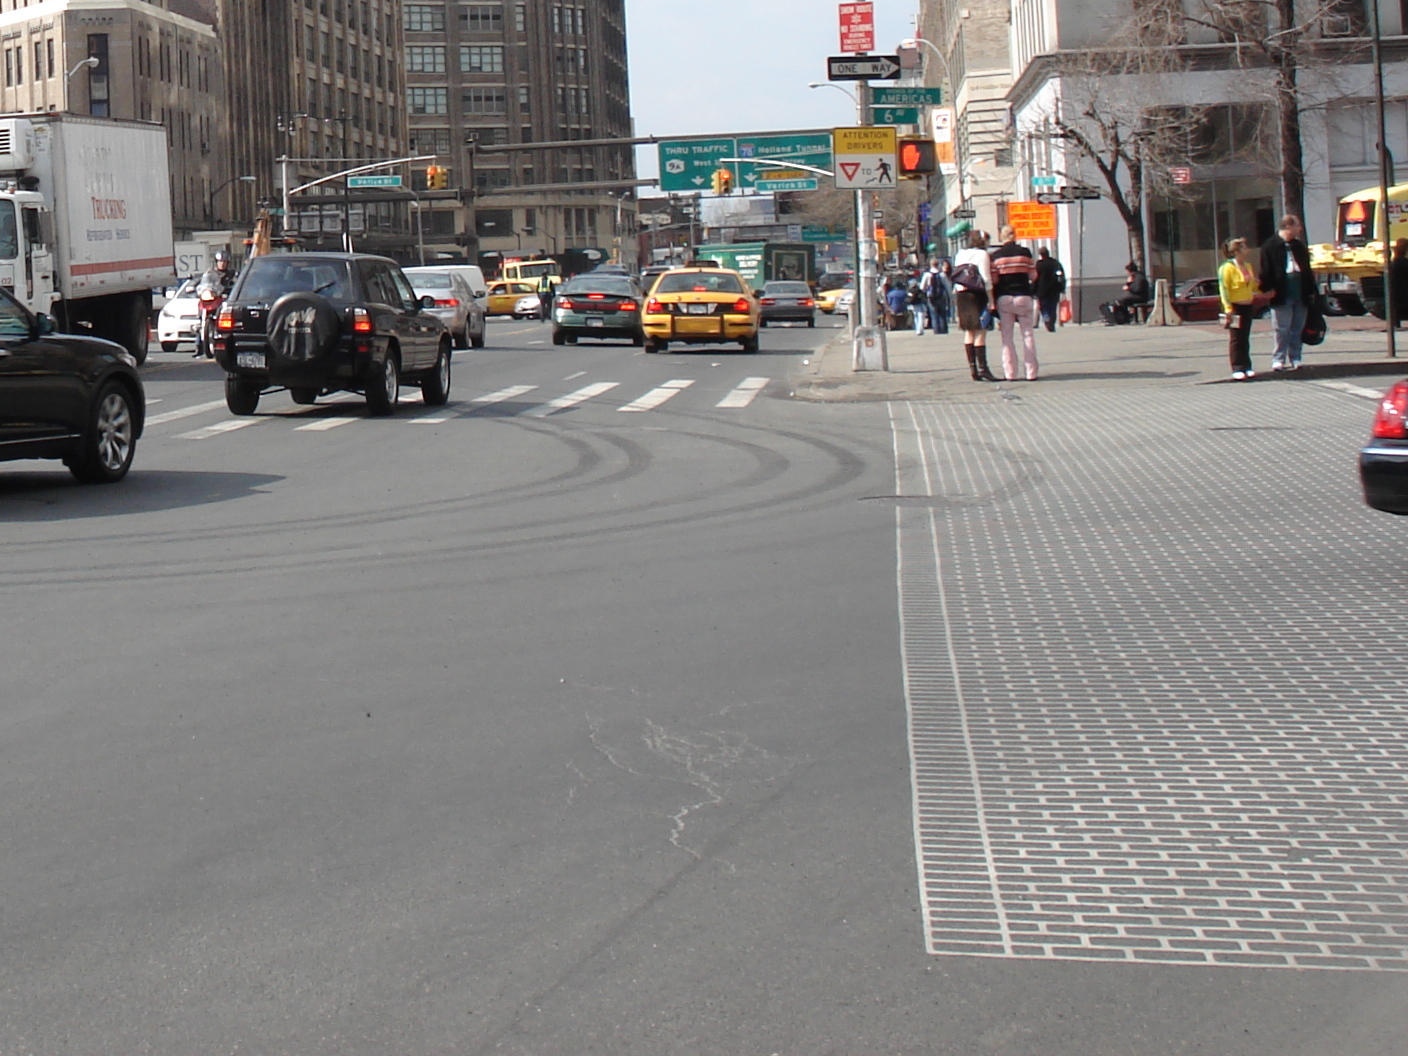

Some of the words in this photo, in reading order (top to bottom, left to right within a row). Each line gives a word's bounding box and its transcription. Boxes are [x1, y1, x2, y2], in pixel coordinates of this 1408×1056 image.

[837, 64, 858, 74] ONE
[872, 62, 892, 73] WAY
[880, 94, 933, 104] AMERICAS
[884, 109, 894, 123] 6
[843, 131, 888, 139] ATTENTION
[665, 146, 689, 155] THRU
[692, 144, 728, 154] TRAFFIC
[758, 146, 792, 154] Holland
[847, 142, 883, 150] DRIVERS
[861, 168, 872, 176] TO
[90, 196, 127, 220] TRUCKING
